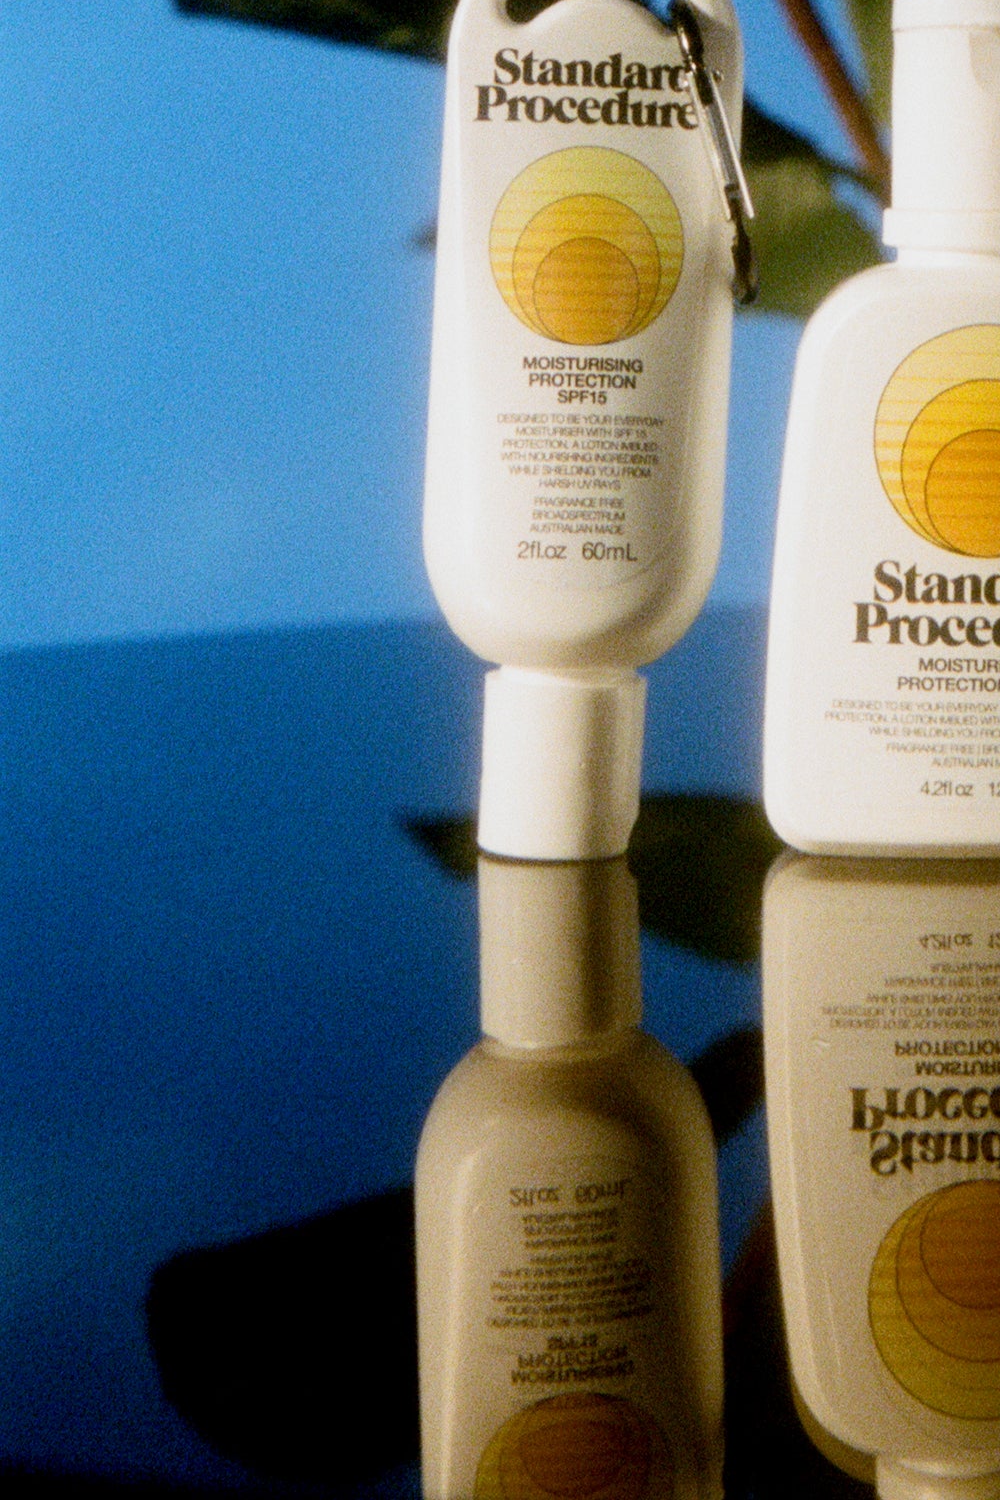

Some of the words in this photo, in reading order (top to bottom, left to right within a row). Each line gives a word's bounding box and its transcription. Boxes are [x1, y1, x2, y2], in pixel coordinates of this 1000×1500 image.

[523, 357, 643, 373] MOISTURISING
[529, 373, 636, 389] PROTECTION
[557, 390, 608, 405] SPF15
[581, 541, 638, 563] 60mL
